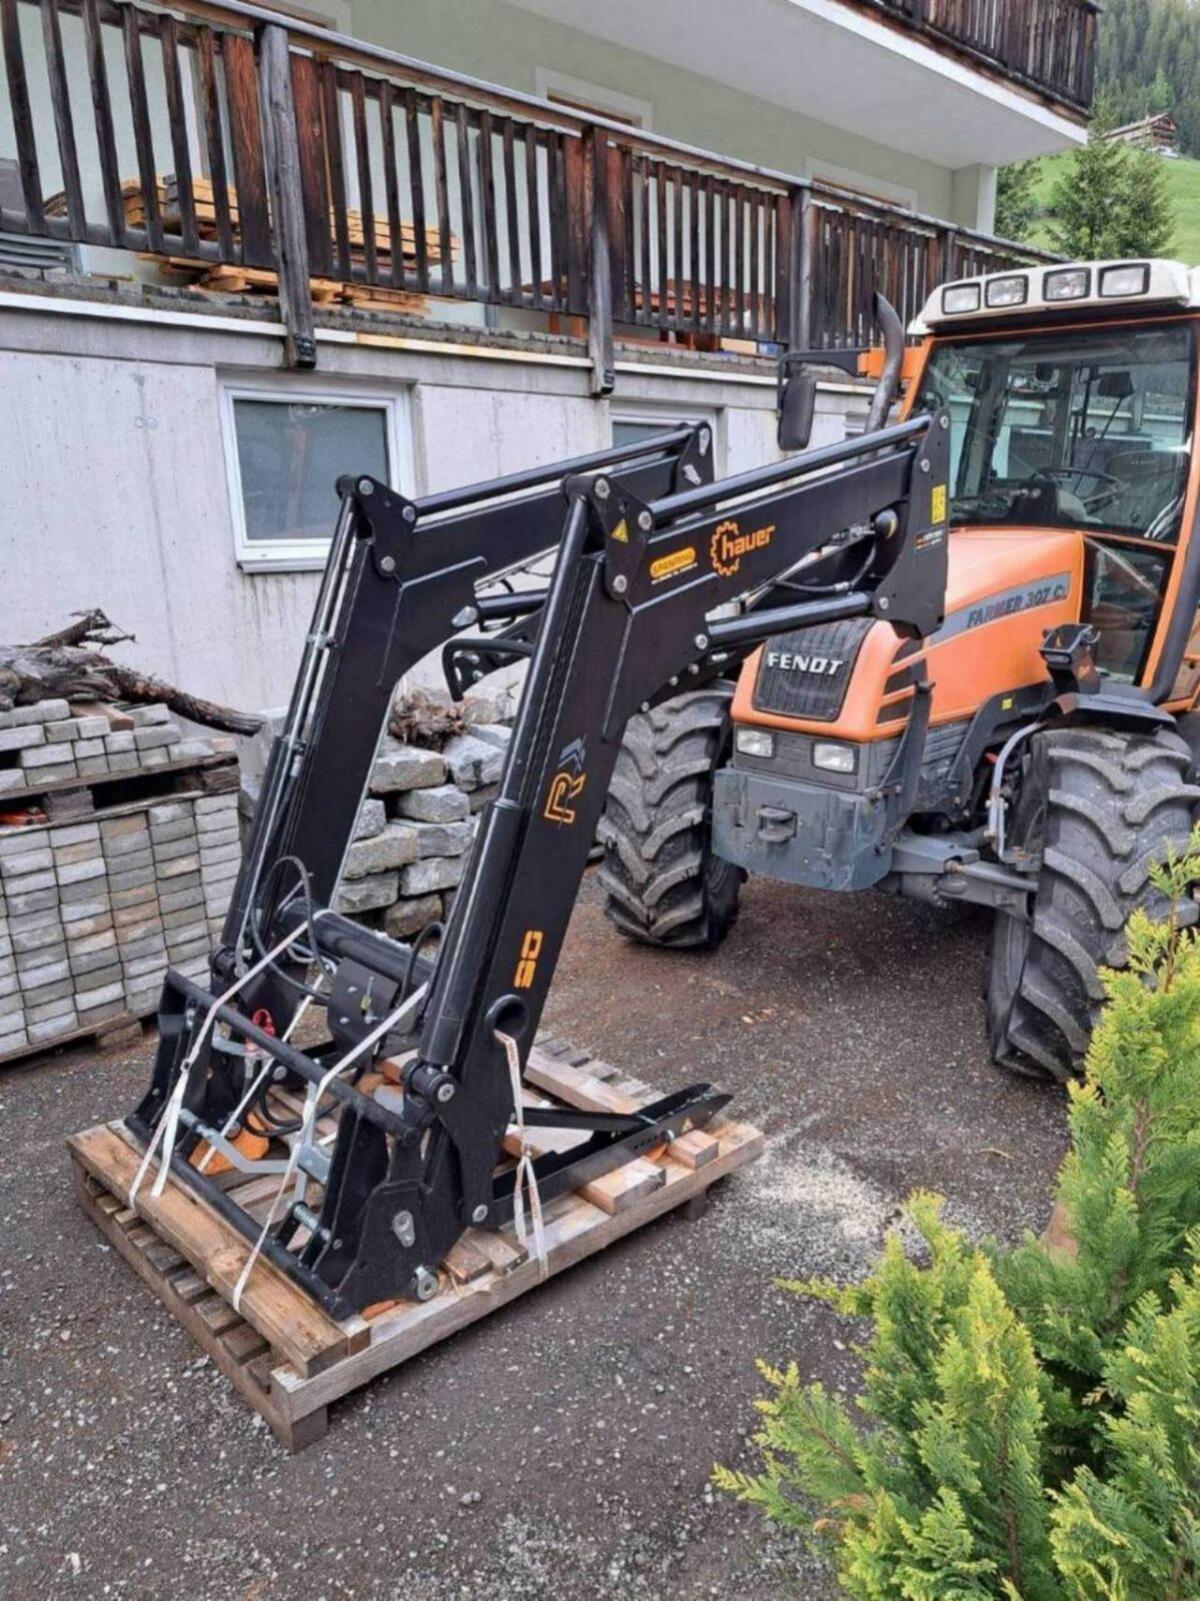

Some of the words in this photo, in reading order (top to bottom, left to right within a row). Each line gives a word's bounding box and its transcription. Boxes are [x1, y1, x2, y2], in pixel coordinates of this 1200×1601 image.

[722, 525, 775, 560] hauer
[966, 594, 1023, 628] FARMER
[1025, 586, 1051, 609] 307
[768, 652, 843, 675] FENDT
